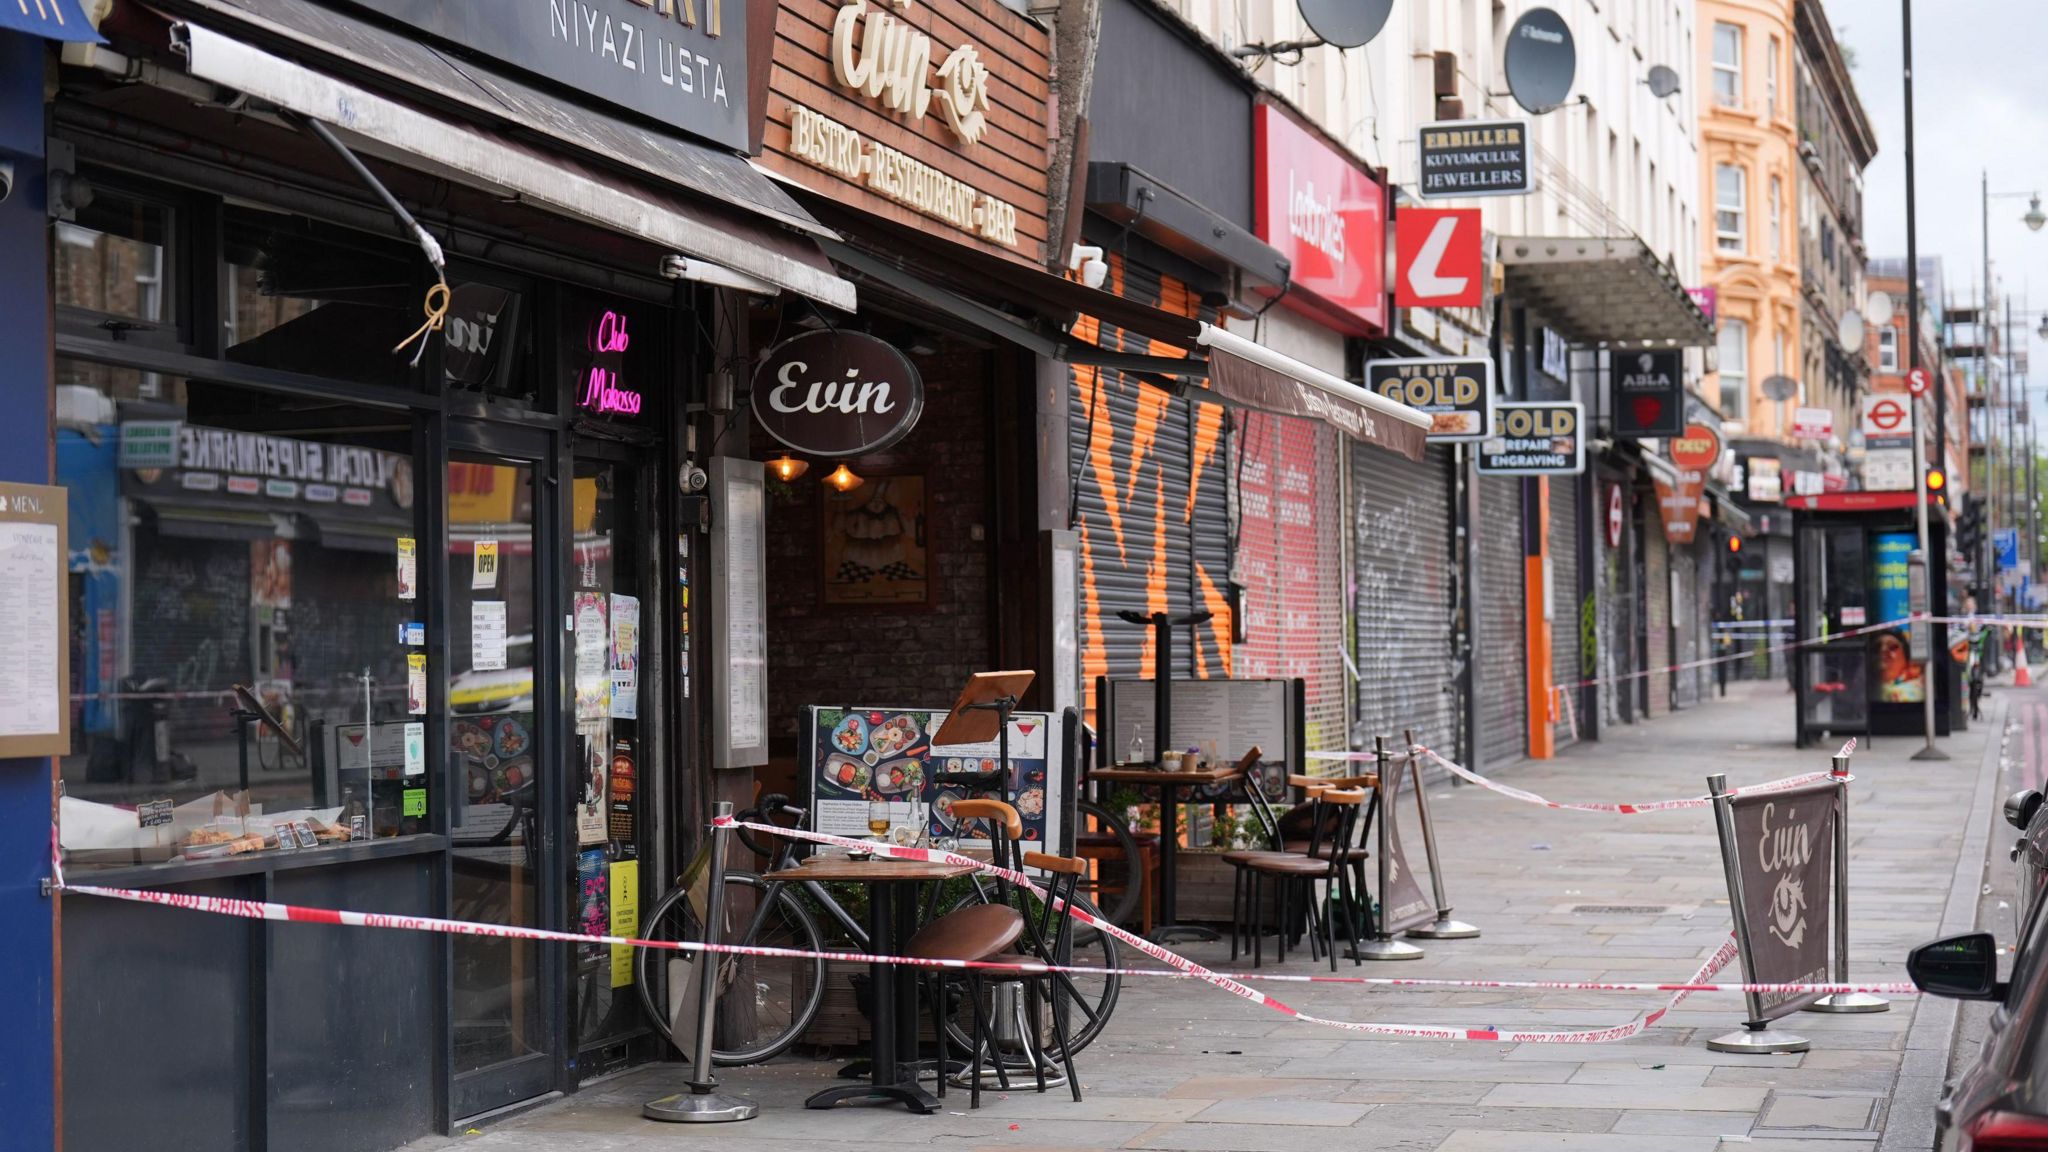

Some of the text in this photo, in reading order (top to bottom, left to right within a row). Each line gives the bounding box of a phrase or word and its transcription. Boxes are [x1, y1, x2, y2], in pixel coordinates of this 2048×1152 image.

[550, 0, 646, 74] NIYAZI
[658, 38, 729, 108] USTA
[1425, 129, 1520, 149] ERBILLER
[1426, 151, 1520, 167] KUYUMCULUK
[1426, 170, 1522, 188] JEWELLERS
[1288, 168, 1345, 263] Ladbrokes
[597, 310, 629, 352] Club
[1398, 365, 1458, 377] WE BUY
[1910, 370, 1925, 392] S
[769, 361, 895, 414] Evin
[1378, 376, 1479, 405] GOLD
[1505, 438, 1550, 451] REPAIR
[1491, 455, 1565, 467] ENGRAVING
[11, 496, 44, 514] MENU
[479, 554, 495, 573] OPEN
[1759, 803, 1812, 873] Evin
